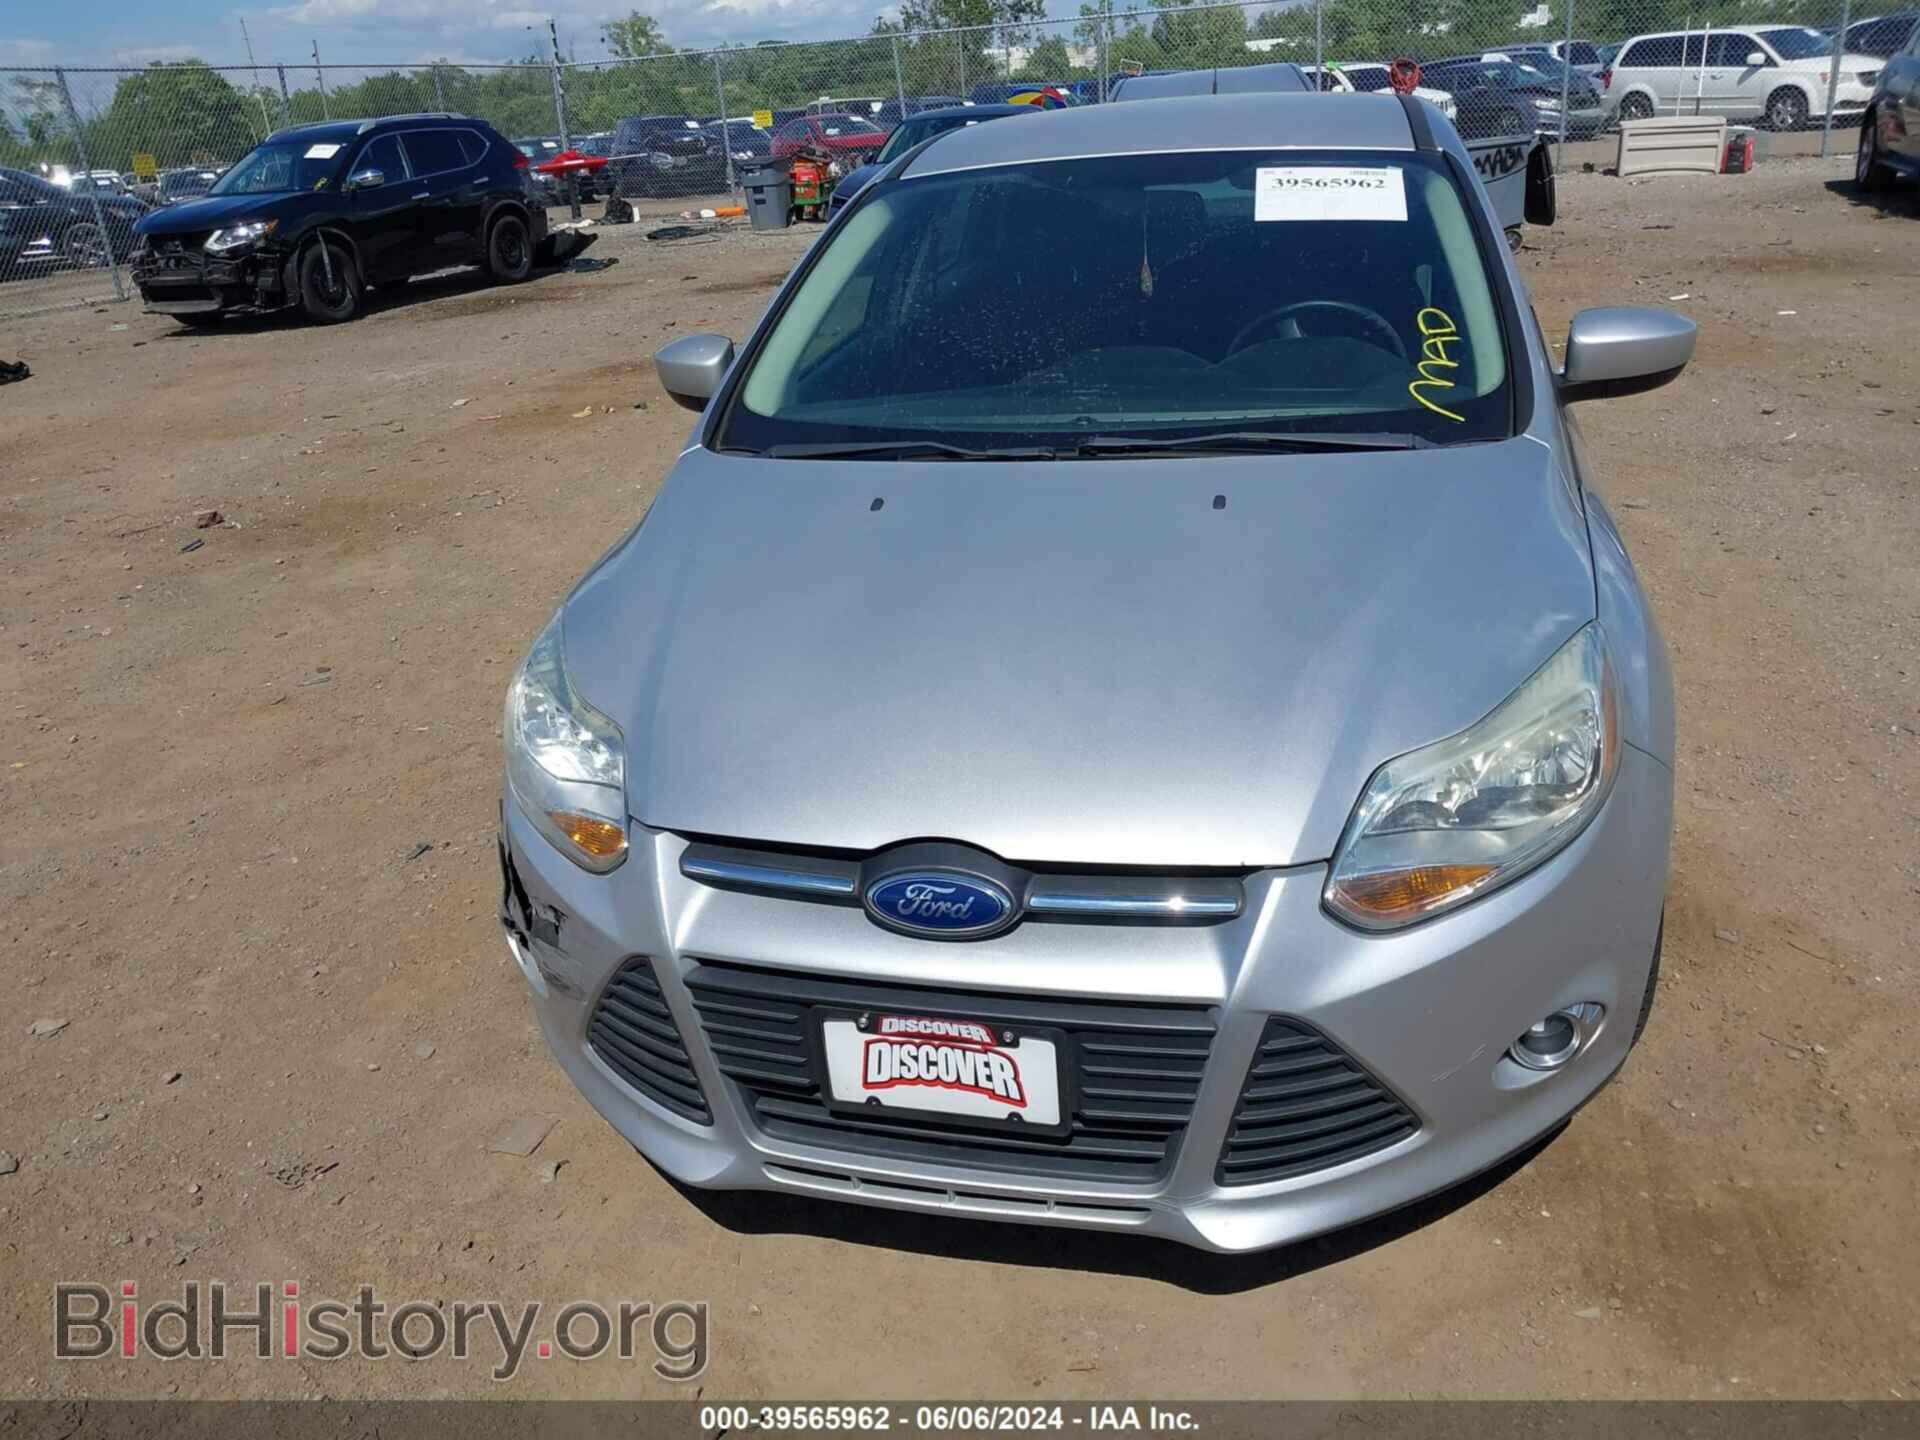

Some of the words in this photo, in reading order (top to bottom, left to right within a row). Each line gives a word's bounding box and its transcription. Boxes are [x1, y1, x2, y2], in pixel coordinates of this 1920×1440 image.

[1271, 177, 1386, 189] 39565962
[897, 883, 976, 920] Ford
[881, 1017, 993, 1043] DISCOVER
[866, 1041, 1022, 1101] DISCOVER
